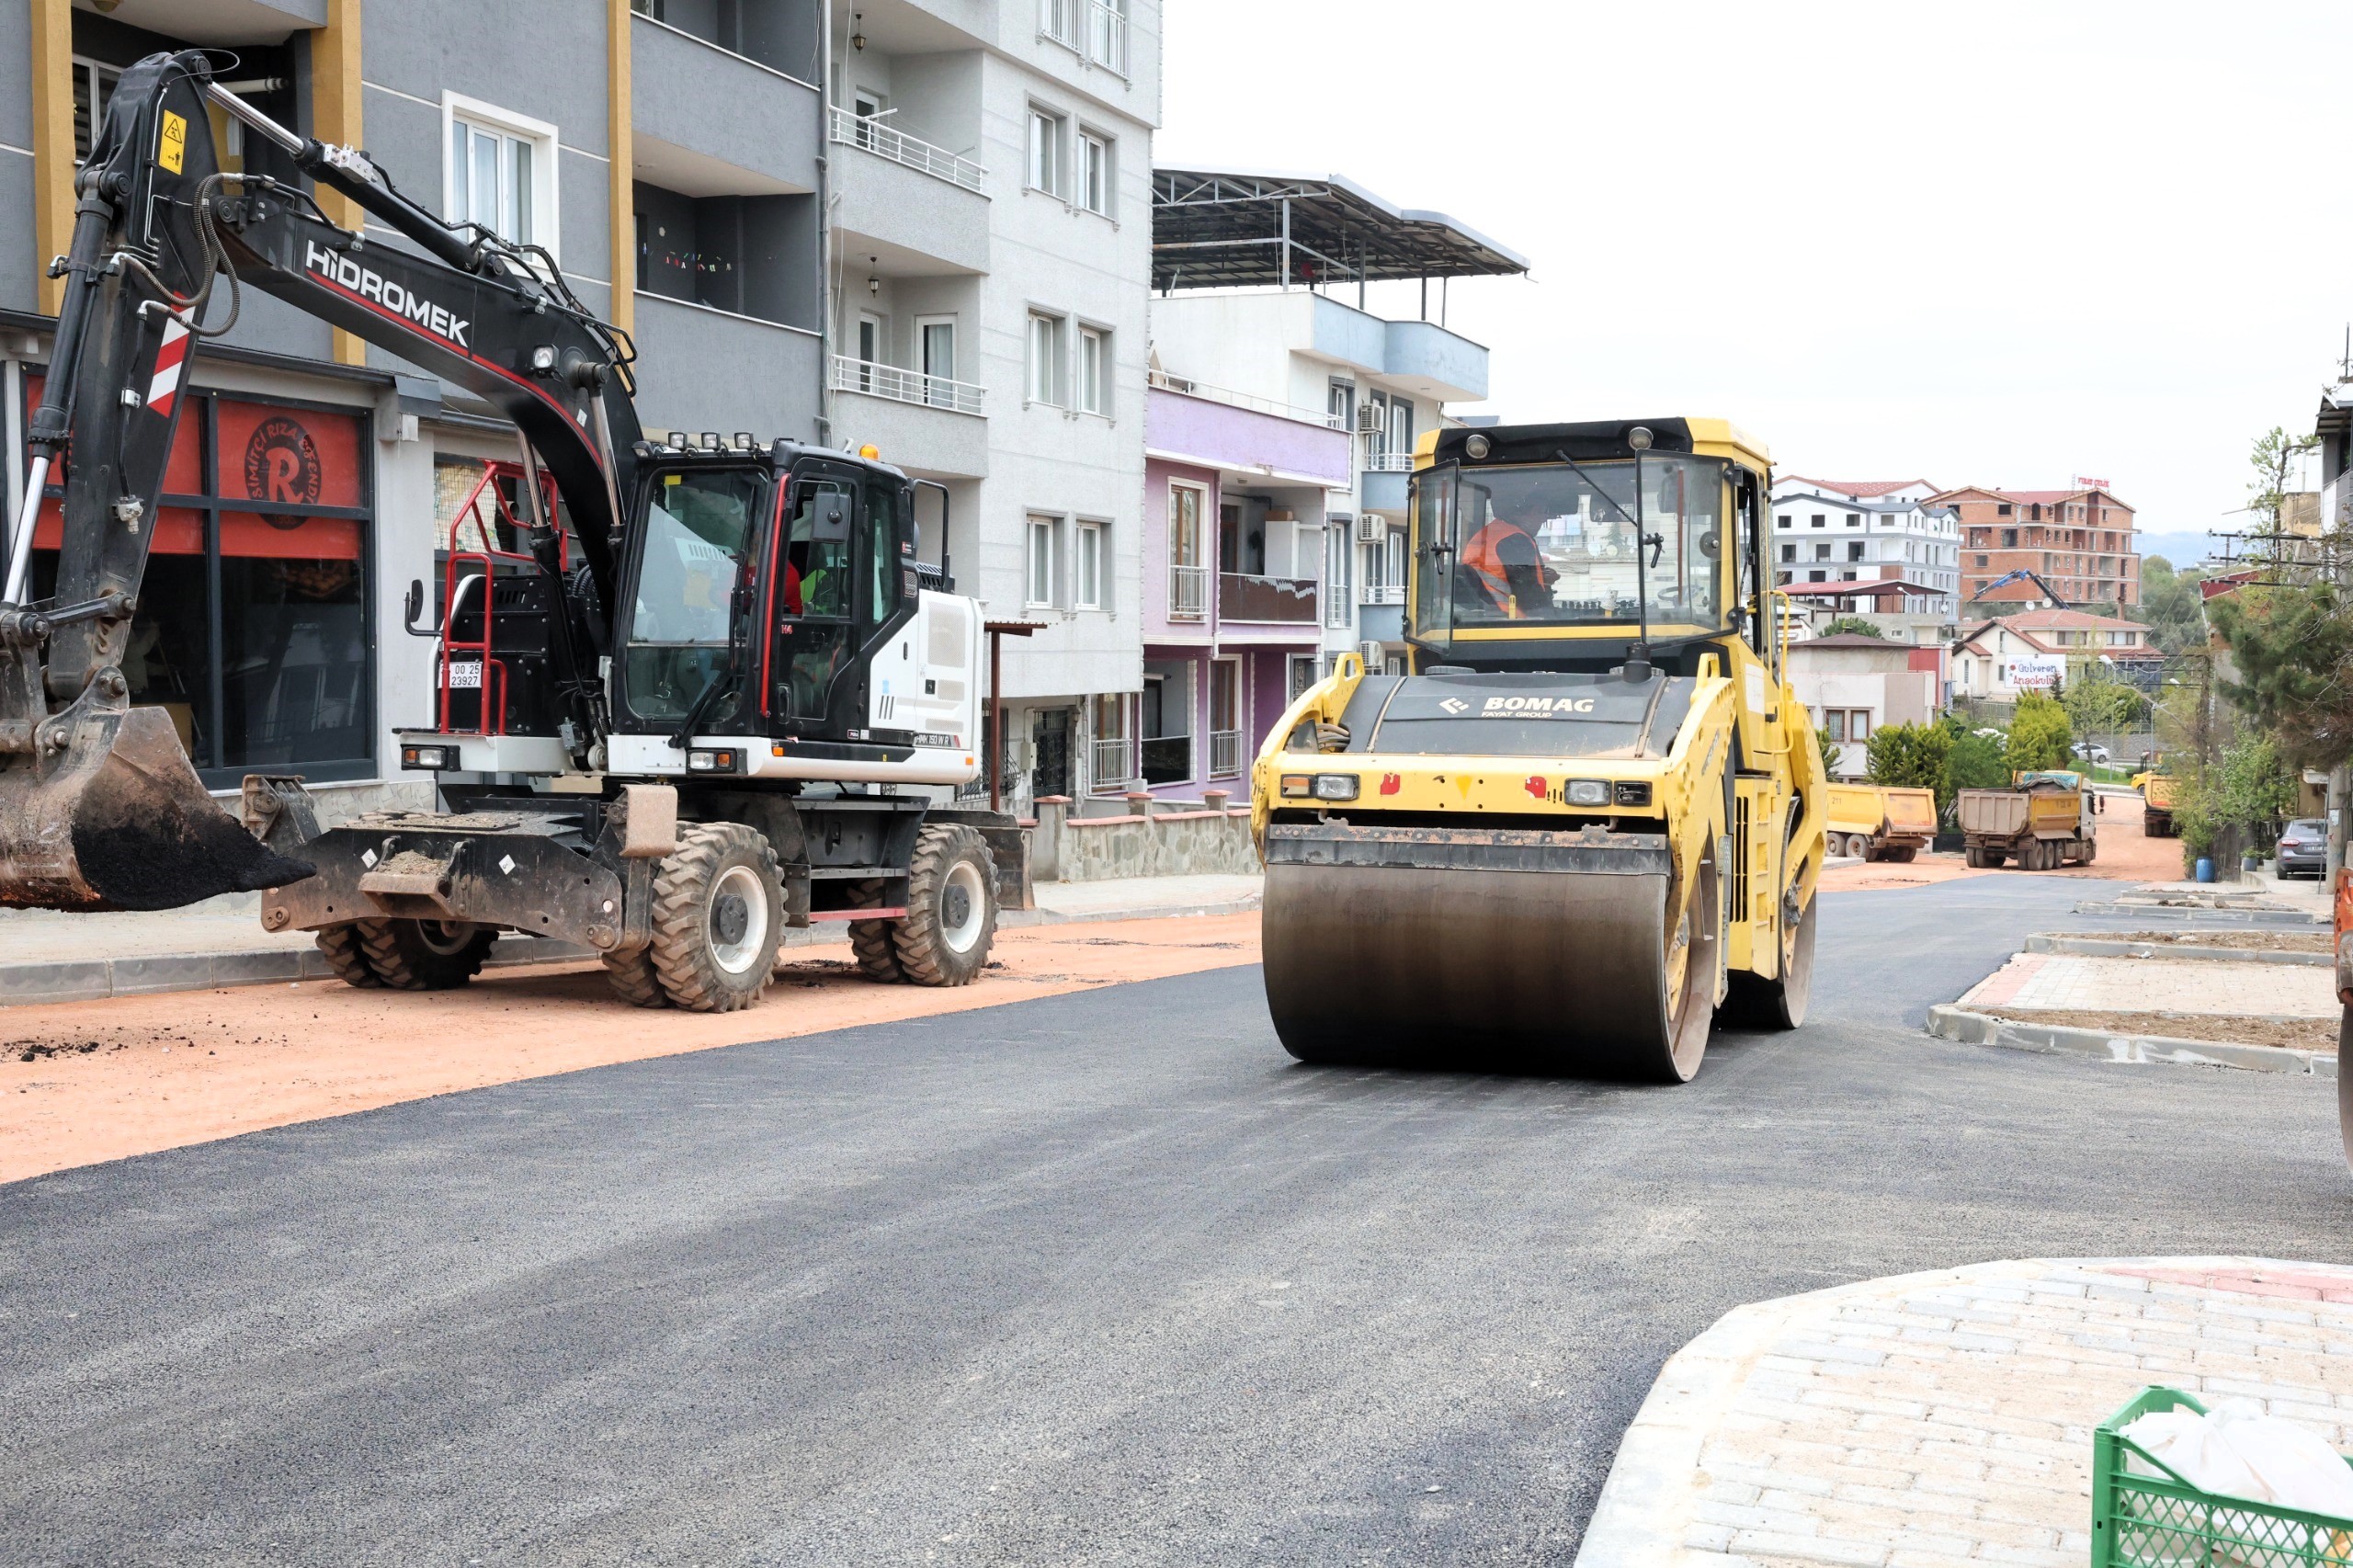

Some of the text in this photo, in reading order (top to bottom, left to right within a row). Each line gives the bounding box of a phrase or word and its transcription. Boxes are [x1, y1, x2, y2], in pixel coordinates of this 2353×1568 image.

[455, 665, 466, 675] 00
[470, 665, 480, 675] 25
[451, 676, 478, 686] 23927
[1483, 697, 1595, 713] BOMAG
